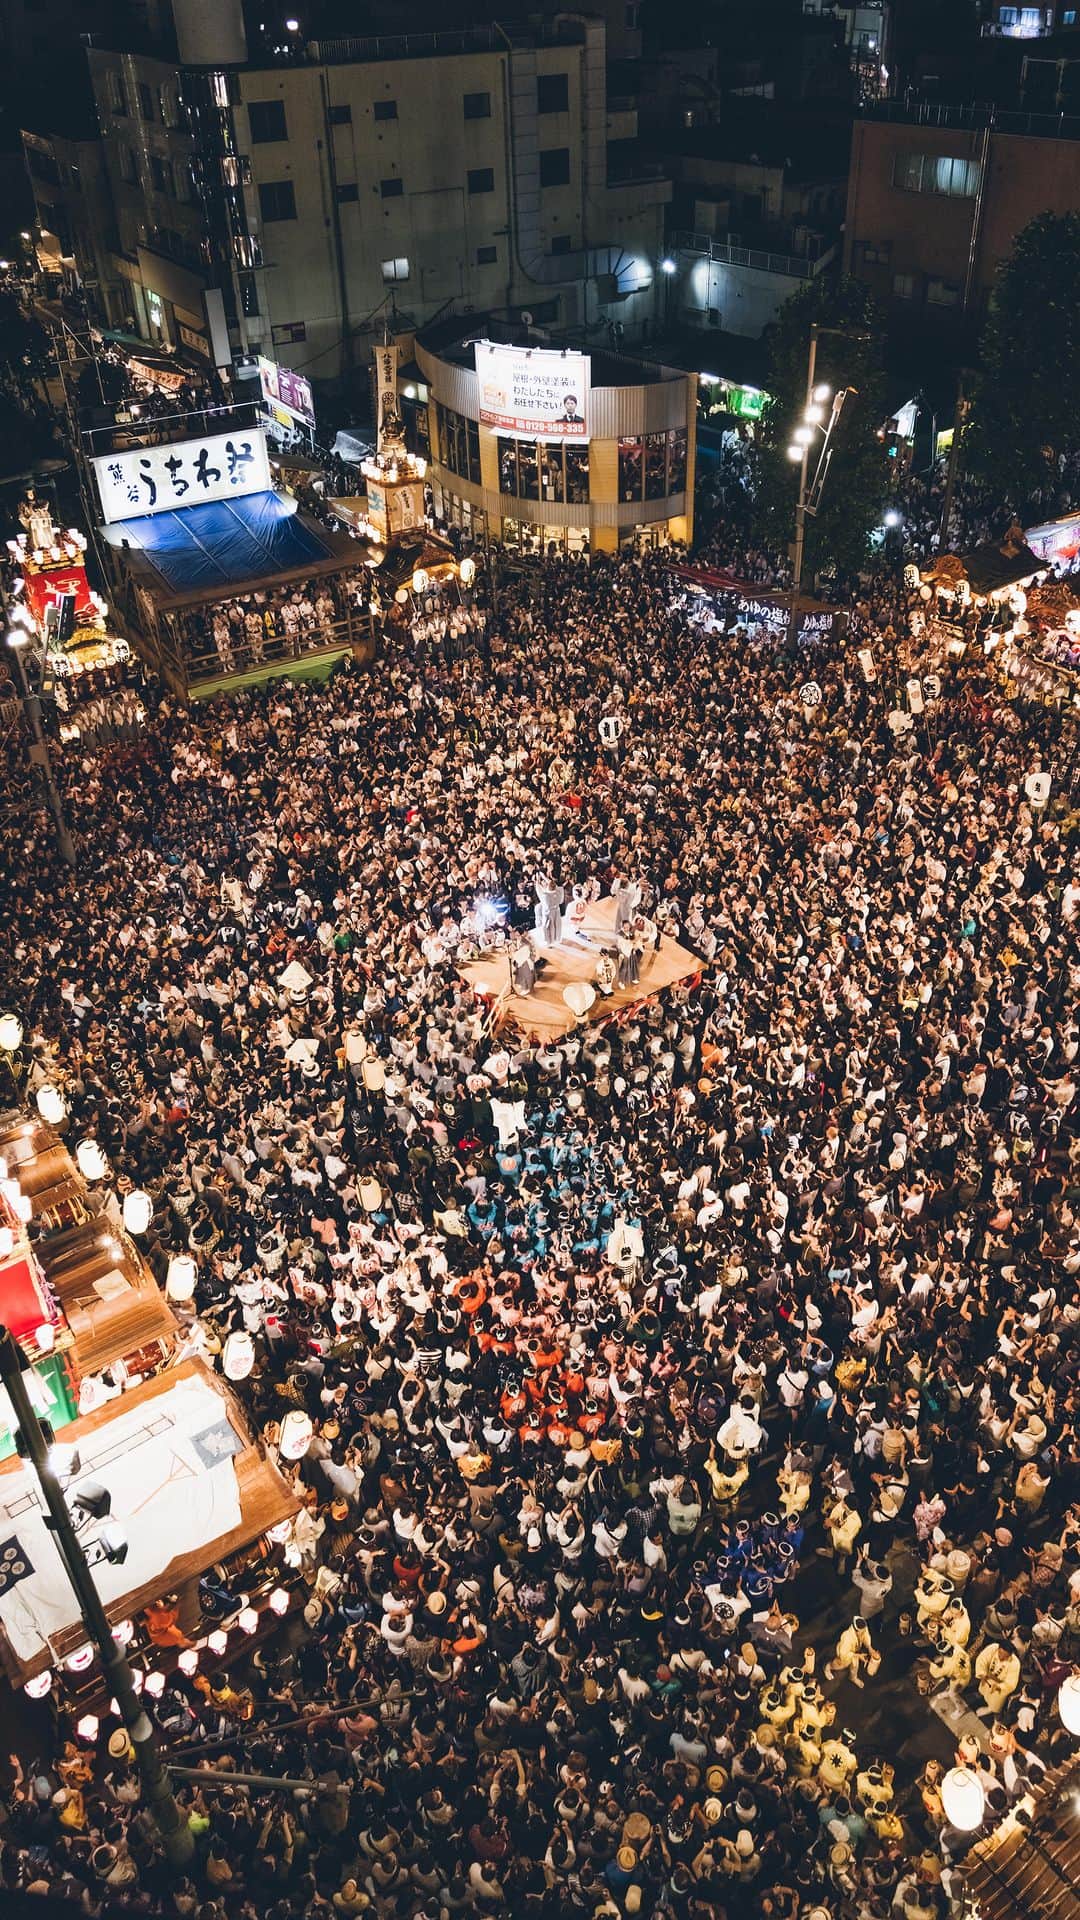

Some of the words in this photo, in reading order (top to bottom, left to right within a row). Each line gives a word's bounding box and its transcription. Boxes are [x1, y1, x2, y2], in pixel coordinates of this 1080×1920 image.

[513, 386, 560, 398] わたしたちに
